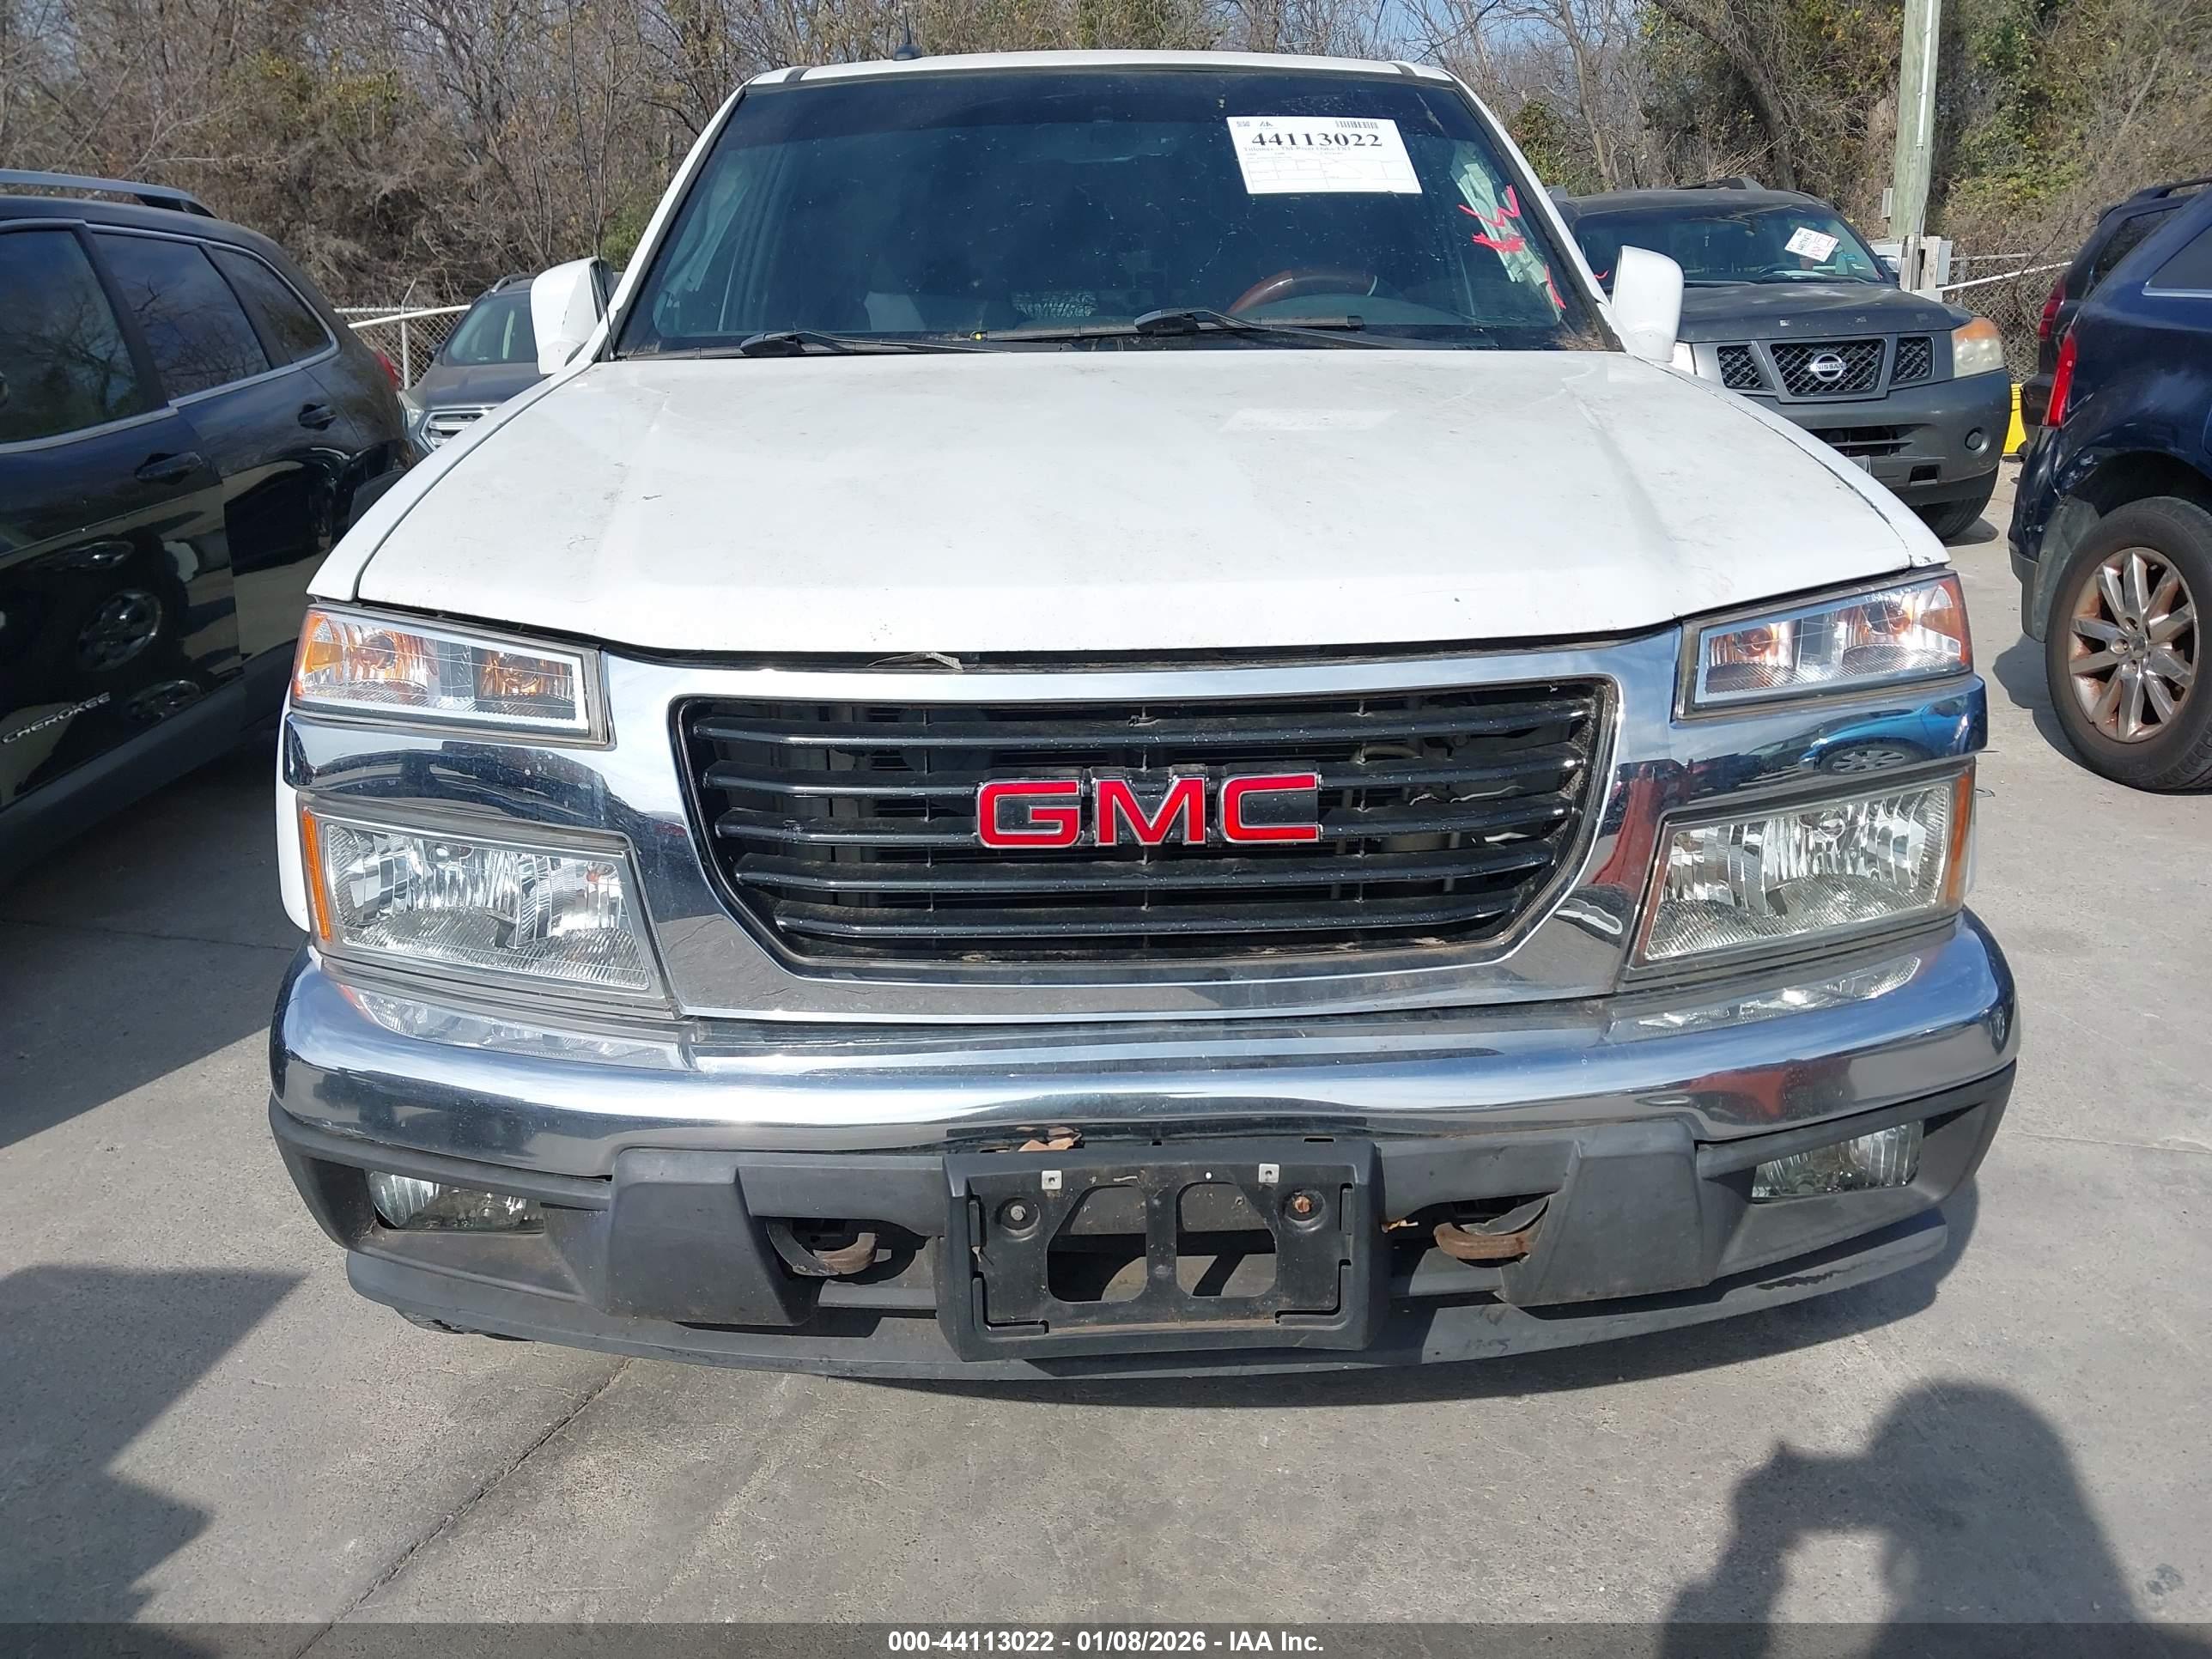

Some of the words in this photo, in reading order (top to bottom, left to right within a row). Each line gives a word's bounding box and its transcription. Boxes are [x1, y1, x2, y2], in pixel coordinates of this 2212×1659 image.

[1251, 132, 1382, 146] 44113022
[2, 691, 111, 744] CHEROKEE
[976, 773, 1321, 848] GMC
